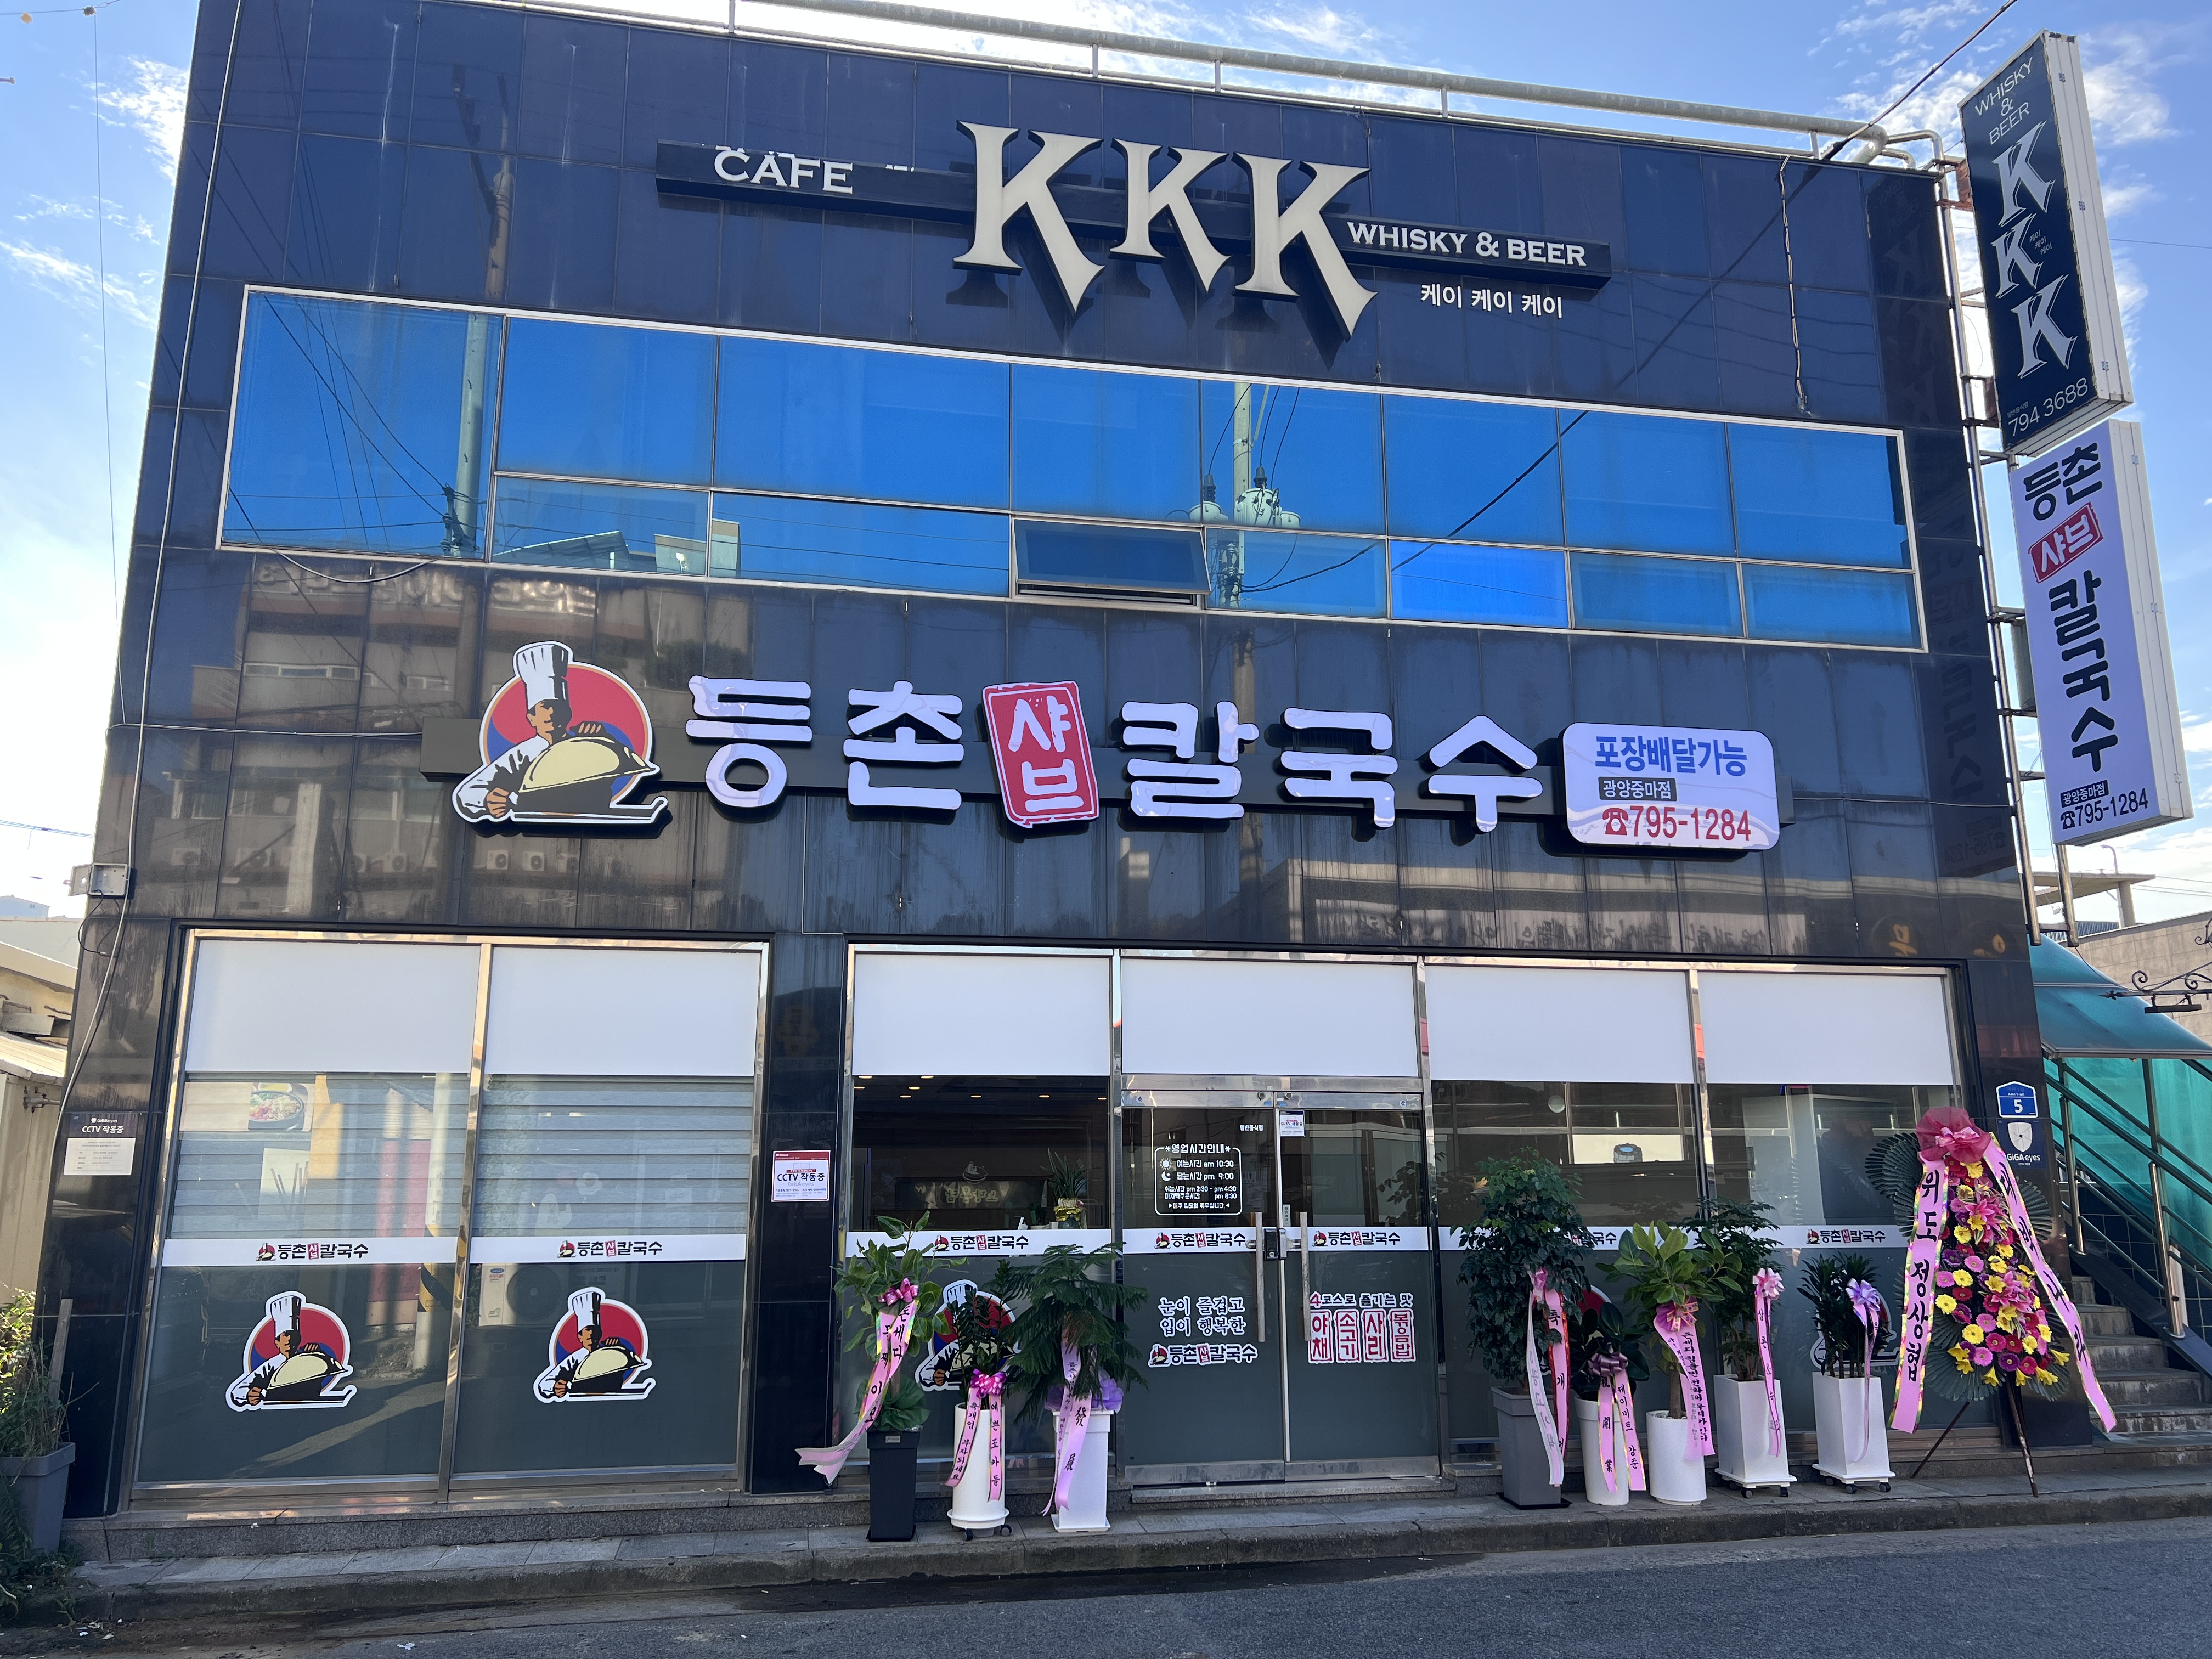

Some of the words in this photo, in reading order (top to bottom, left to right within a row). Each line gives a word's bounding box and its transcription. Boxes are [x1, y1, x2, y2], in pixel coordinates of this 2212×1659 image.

[1975, 57, 2033, 117] WHISKY
[1989, 101, 2030, 146] BEER
[2000, 98, 2014, 115] &
[714, 149, 854, 195] CAFE
[1347, 221, 1468, 255] WHISKY
[1476, 232, 1499, 258] &
[1506, 238, 1587, 267] BEER
[1420, 284, 1462, 309] 케이
[1471, 289, 1513, 314] 케이
[1521, 295, 1563, 318] 케이
[2008, 405, 2041, 437] 794
[2042, 377, 2089, 416] 3688
[2023, 441, 2103, 521] 등촌
[2049, 570, 2119, 772] 칼국수
[1595, 736, 1747, 776] 포장배달가능
[1602, 780, 1672, 799] 광양중마점
[2062, 783, 2106, 805] 광양중마점
[2074, 787, 2149, 826] 795-1284
[1630, 805, 1752, 842] 795-1284
[2013, 1099, 2023, 1114] 5
[102, 1125, 124, 1134] 작동중
[777, 1173, 799, 1181] CCTV
[800, 1172, 825, 1181] 작동중
[1176, 1160, 1202, 1168] 여는시간
[1176, 1172, 1203, 1180] 닫는시간
[1159, 1296, 1190, 1315] 눈이
[1197, 1296, 1244, 1315] 즐겁고
[1310, 1293, 1356, 1307] 4코스로
[1361, 1294, 1396, 1307] 즐기는
[1401, 1294, 1412, 1307] 맛
[1161, 1317, 1190, 1336] 입이
[1198, 1317, 1245, 1335] 행복한
[1312, 1314, 1328, 1359] 야채
[1339, 1313, 1356, 1358] 소고기
[1366, 1313, 1383, 1357] 사리
[1393, 1313, 1410, 1357] 볶음밥
